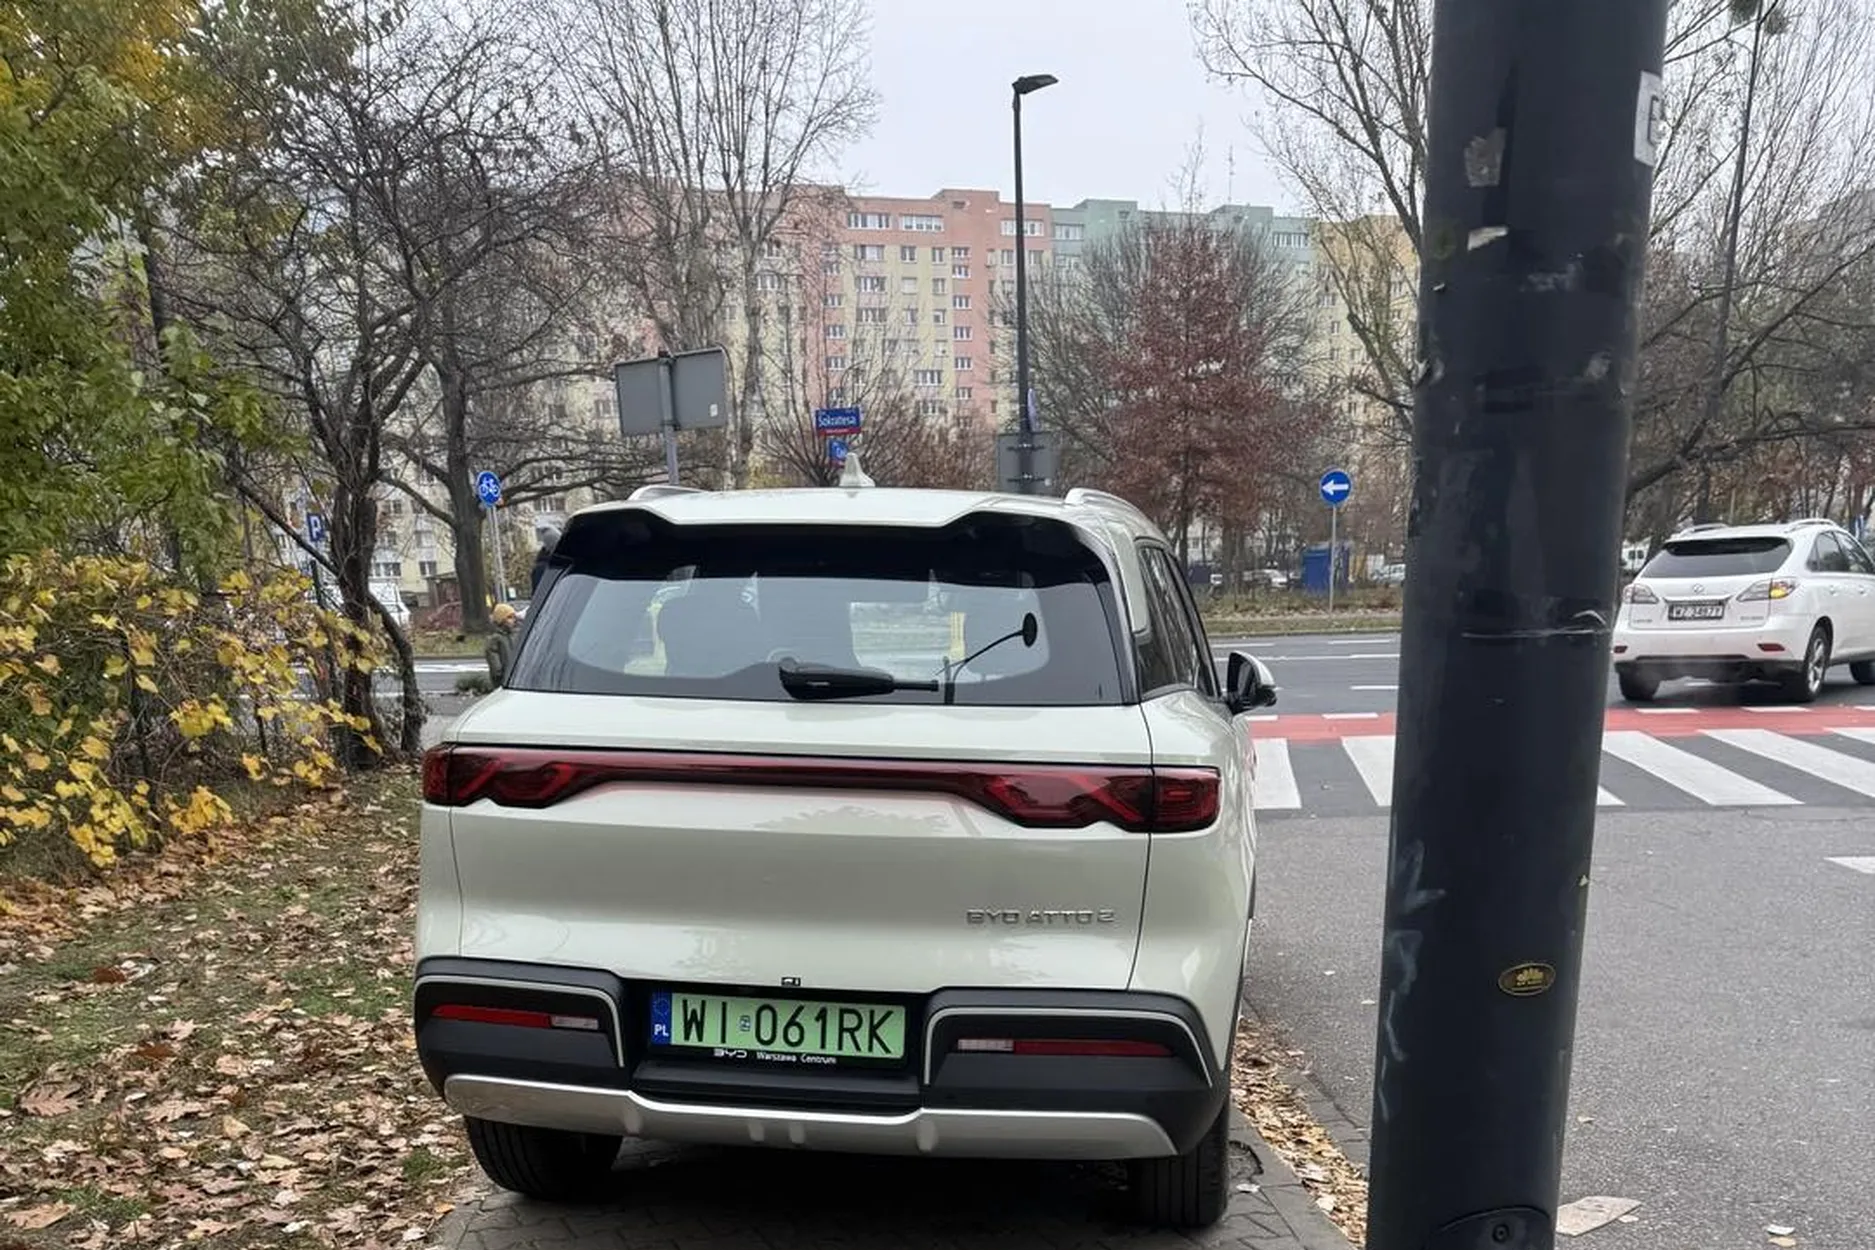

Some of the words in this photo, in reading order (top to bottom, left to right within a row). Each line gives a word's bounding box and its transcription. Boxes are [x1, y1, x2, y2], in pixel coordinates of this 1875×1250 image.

[310, 515, 321, 539] P
[966, 909, 1020, 924] BYD
[1026, 908, 1094, 924] ATTO
[1097, 909, 1115, 923] 2
[654, 1023, 669, 1037] PL
[682, 999, 727, 1044] WI
[755, 1003, 894, 1054] 061RK
[713, 1047, 747, 1059] BYD
[756, 1051, 797, 1062] Warszawa
[800, 1053, 837, 1064] Centrum
